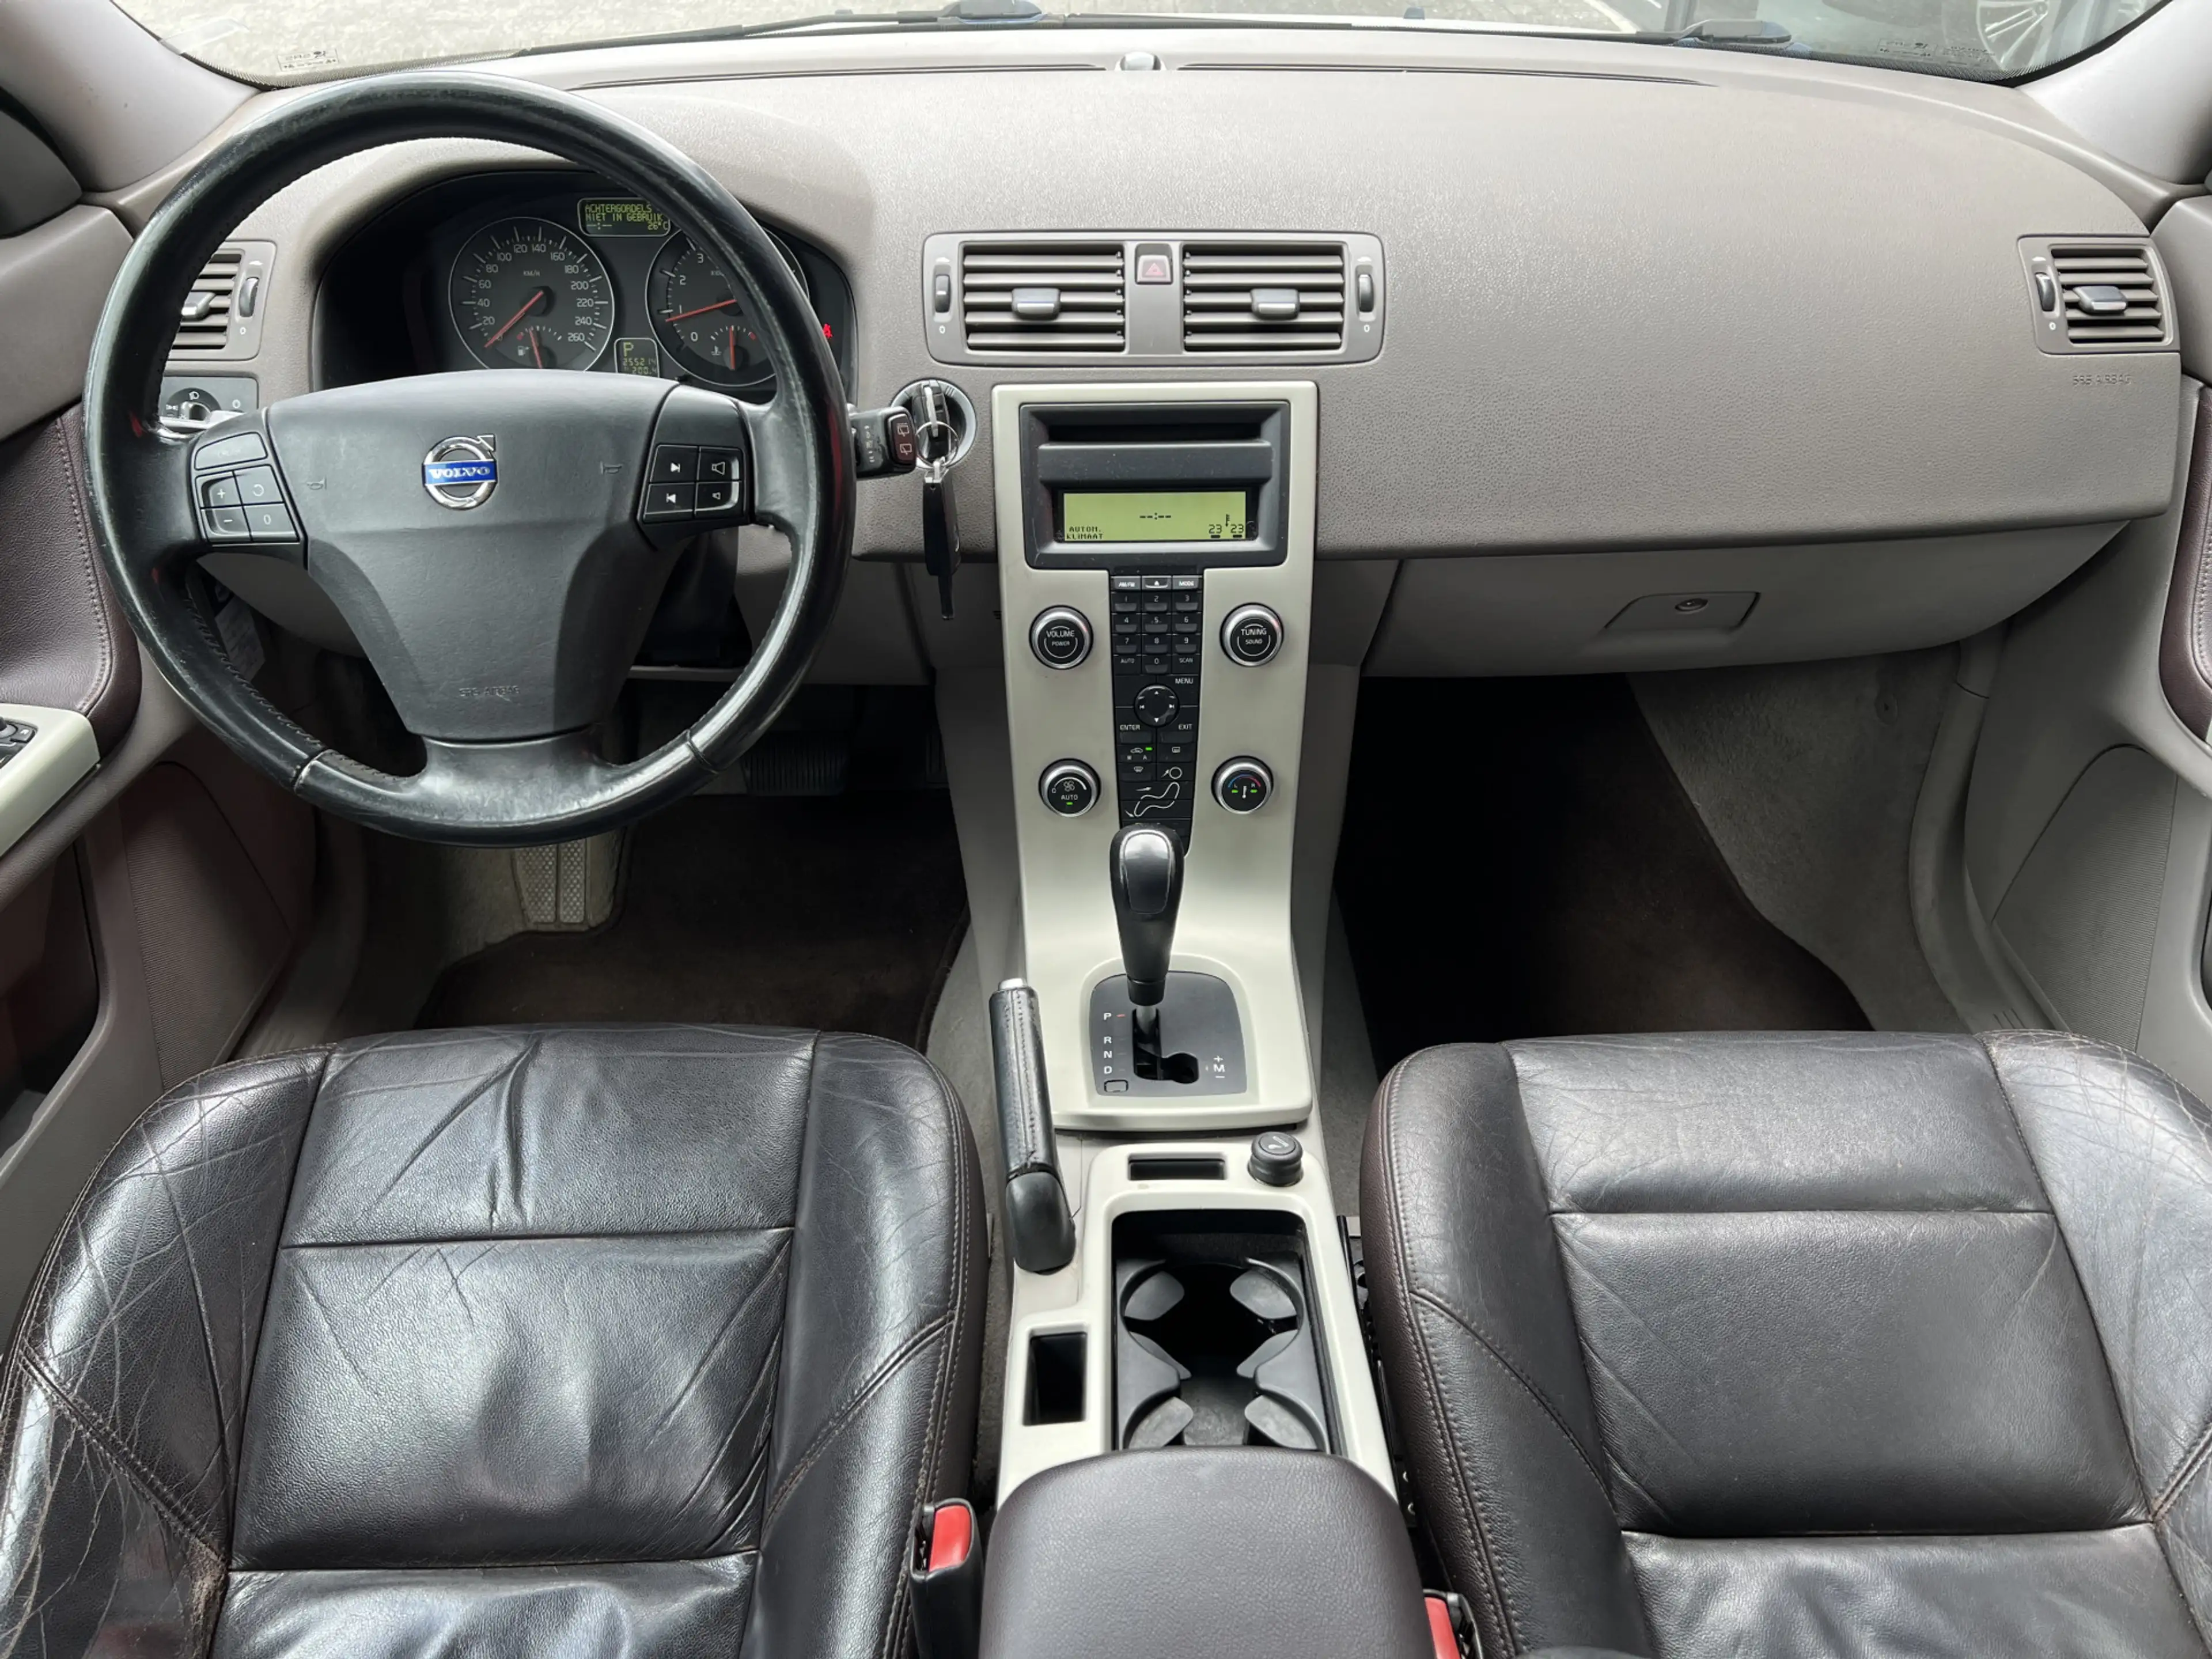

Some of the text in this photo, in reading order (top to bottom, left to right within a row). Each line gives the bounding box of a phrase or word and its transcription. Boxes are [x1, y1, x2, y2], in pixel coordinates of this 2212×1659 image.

[585, 204, 653, 213] ACHTERGORDELS
[585, 213, 663, 222] NIET IN GEBRUIK
[513, 244, 528, 253] 120
[532, 244, 547, 252] 140
[497, 252, 512, 262] 100
[550, 252, 565, 261] 160
[697, 253, 704, 263] 3
[486, 264, 499, 273] 80
[565, 264, 579, 274] 180
[479, 280, 491, 289] 60
[679, 275, 687, 285] 2
[571, 281, 589, 290] 200
[477, 298, 490, 307] 40
[577, 298, 594, 307] 220
[482, 316, 495, 325] 20
[575, 316, 592, 325] 240
[568, 333, 585, 342] 260
[691, 332, 699, 342] 0
[623, 342, 634, 357] P
[429, 466, 491, 479] VOLVO
[1208, 524, 1222, 535] 23
[1230, 524, 1244, 534] 23
[1046, 630, 1075, 638] VOLUME
[1240, 628, 1267, 636] TUNING
[1103, 1012, 1112, 1021] P
[1103, 1051, 1113, 1059] N
[1103, 1066, 1113, 1074] D
[1213, 1065, 1226, 1073] M
